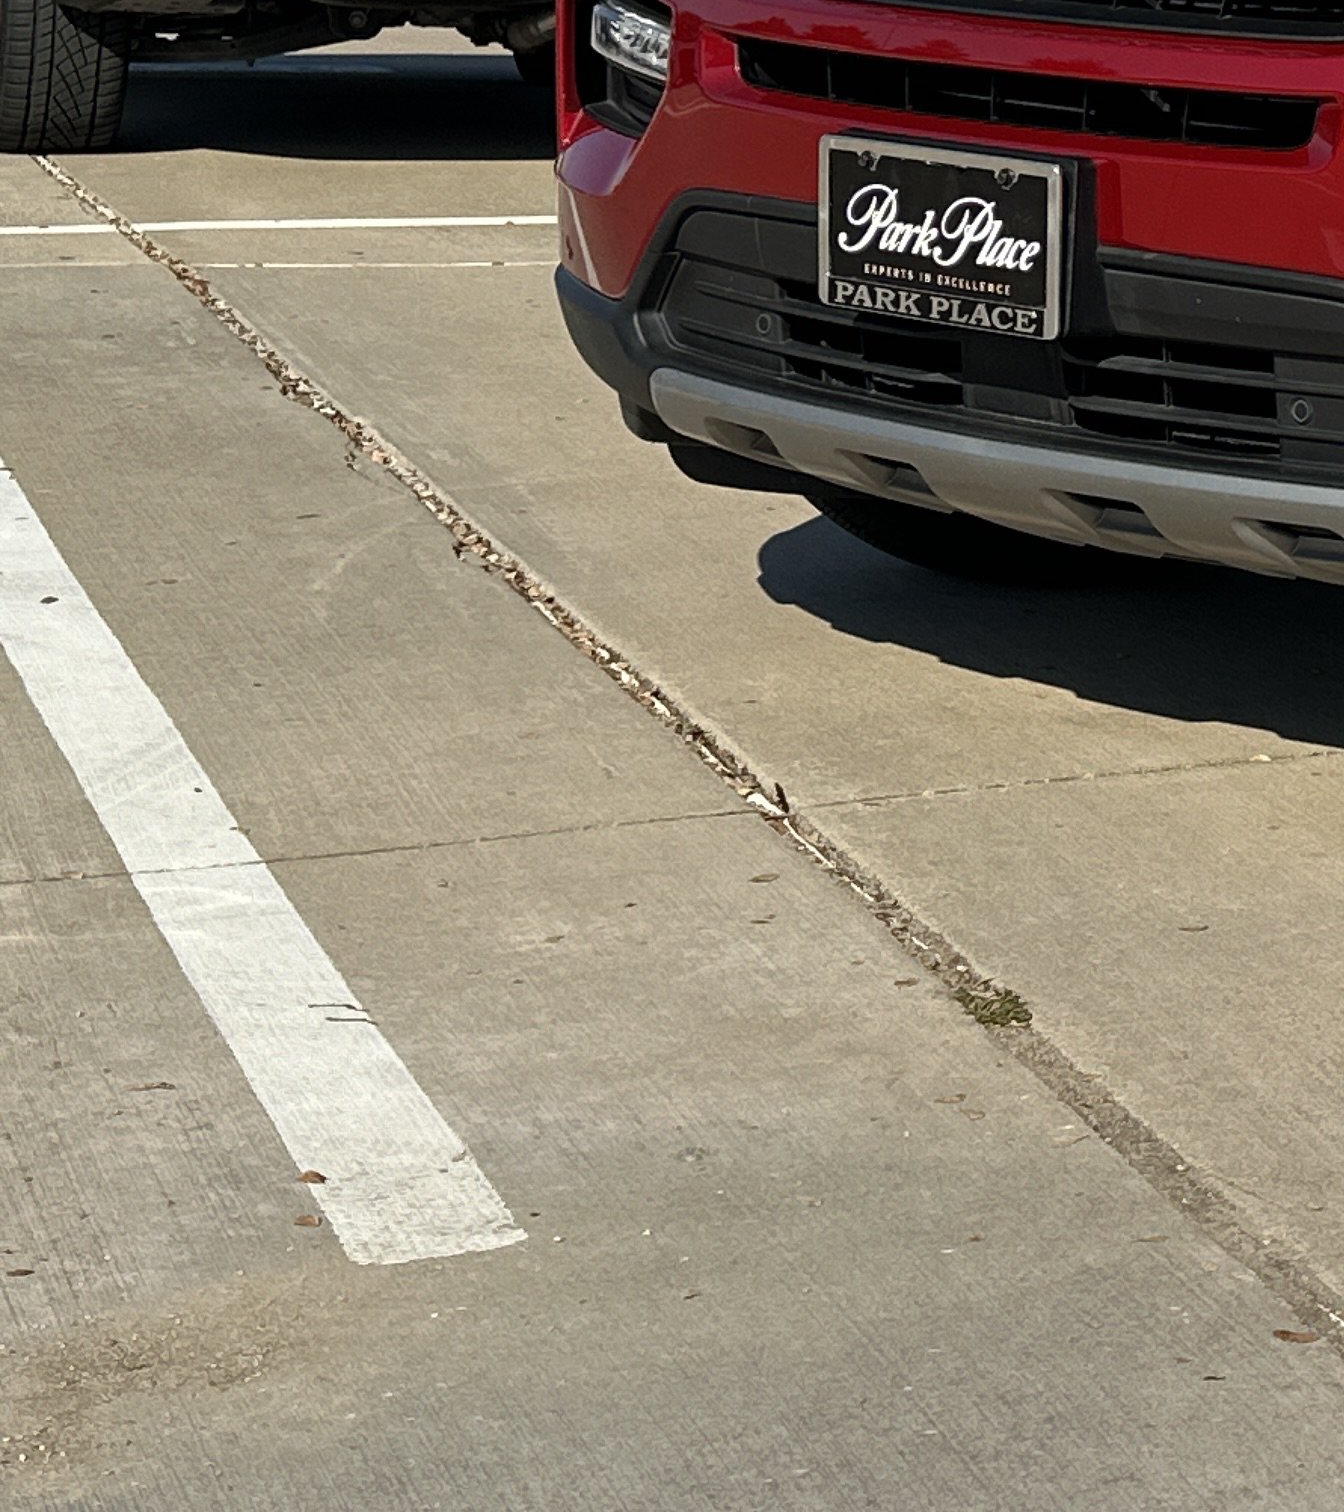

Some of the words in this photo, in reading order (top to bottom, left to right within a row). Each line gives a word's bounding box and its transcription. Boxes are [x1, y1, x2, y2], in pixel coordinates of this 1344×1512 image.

[838, 184, 939, 257] Park
[932, 197, 1041, 271] Place
[833, 280, 922, 317] PARK
[928, 296, 1038, 334] PLACE
[864, 263, 914, 281] EXPERTS
[918, 272, 932, 283] IN
[936, 274, 1011, 297] EXCELLENCE
